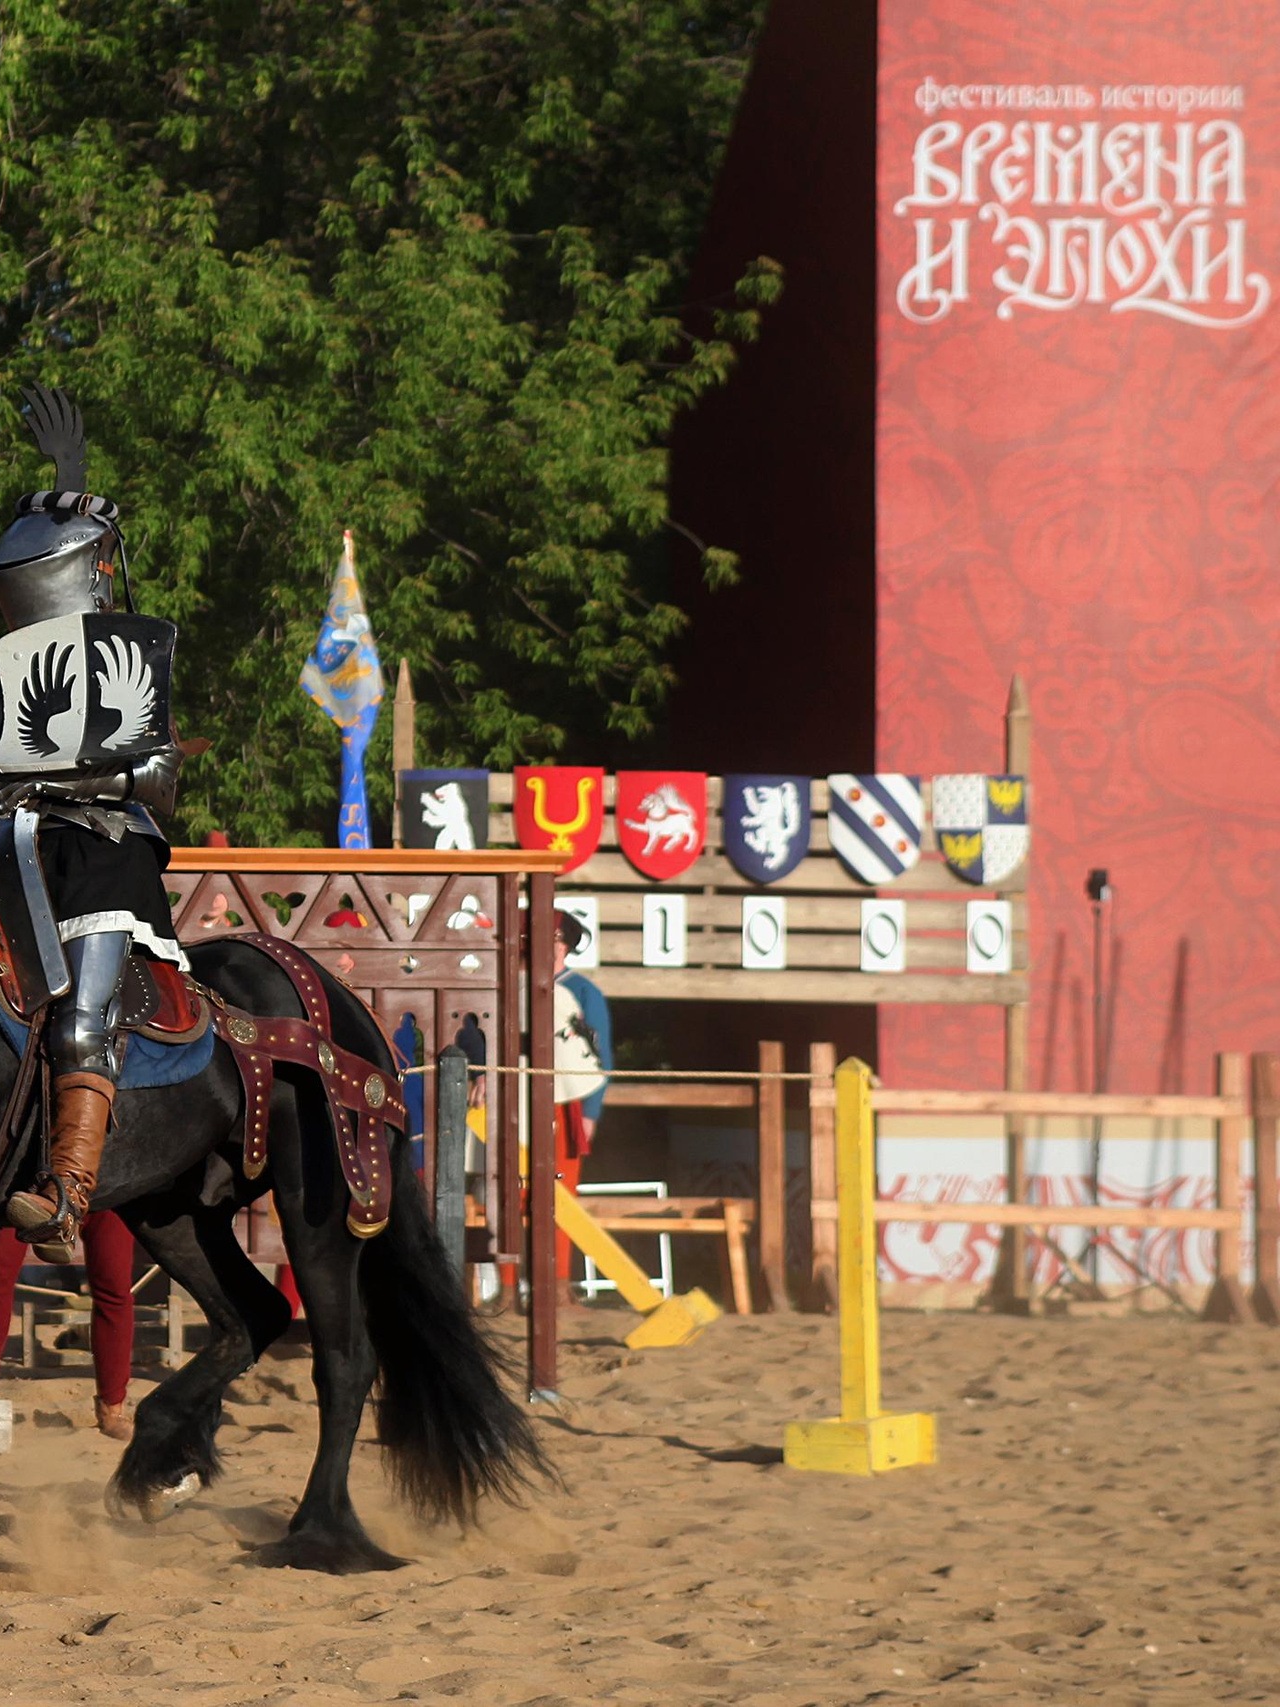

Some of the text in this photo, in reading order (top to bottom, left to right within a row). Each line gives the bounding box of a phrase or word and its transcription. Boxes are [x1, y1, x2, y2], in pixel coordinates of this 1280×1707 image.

[914, 76, 1244, 115] фестиваль истории
[893, 119, 1246, 220] ВРЕМЕНА
[896, 202, 1271, 330] И ЭПОХИ
